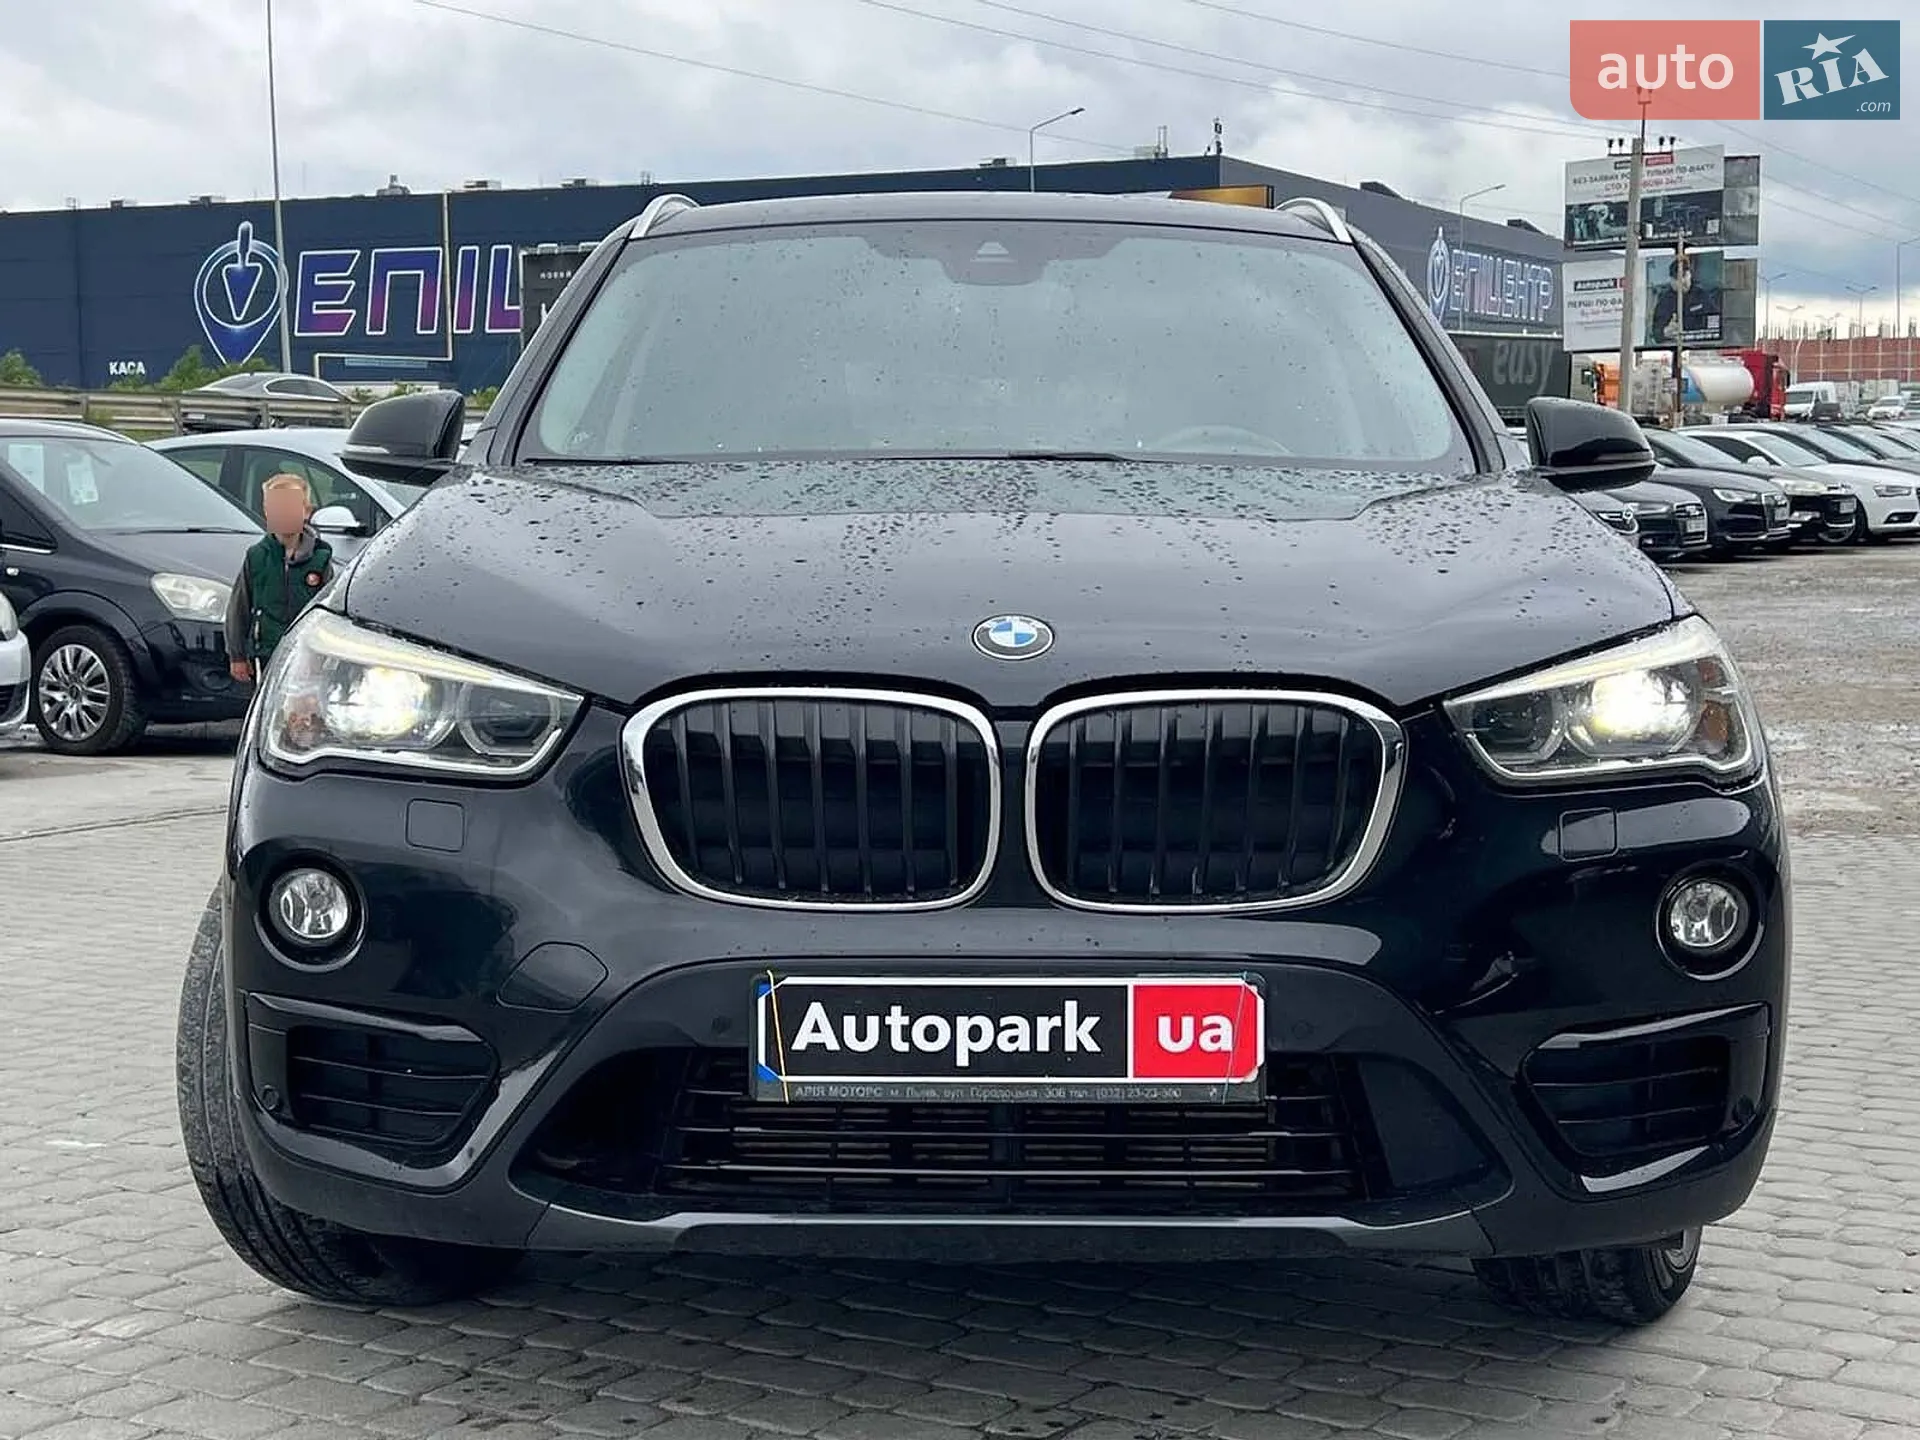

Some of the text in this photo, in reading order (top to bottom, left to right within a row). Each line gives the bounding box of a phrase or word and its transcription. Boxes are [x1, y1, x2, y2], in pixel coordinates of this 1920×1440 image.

[1450, 249, 1554, 322] ЕПІЦЕНТР
[109, 361, 146, 375] КАСА
[1493, 339, 1556, 395] easy
[791, 1001, 1234, 1066] Autopark ua
[828, 1085, 882, 1098] МОТОРС
